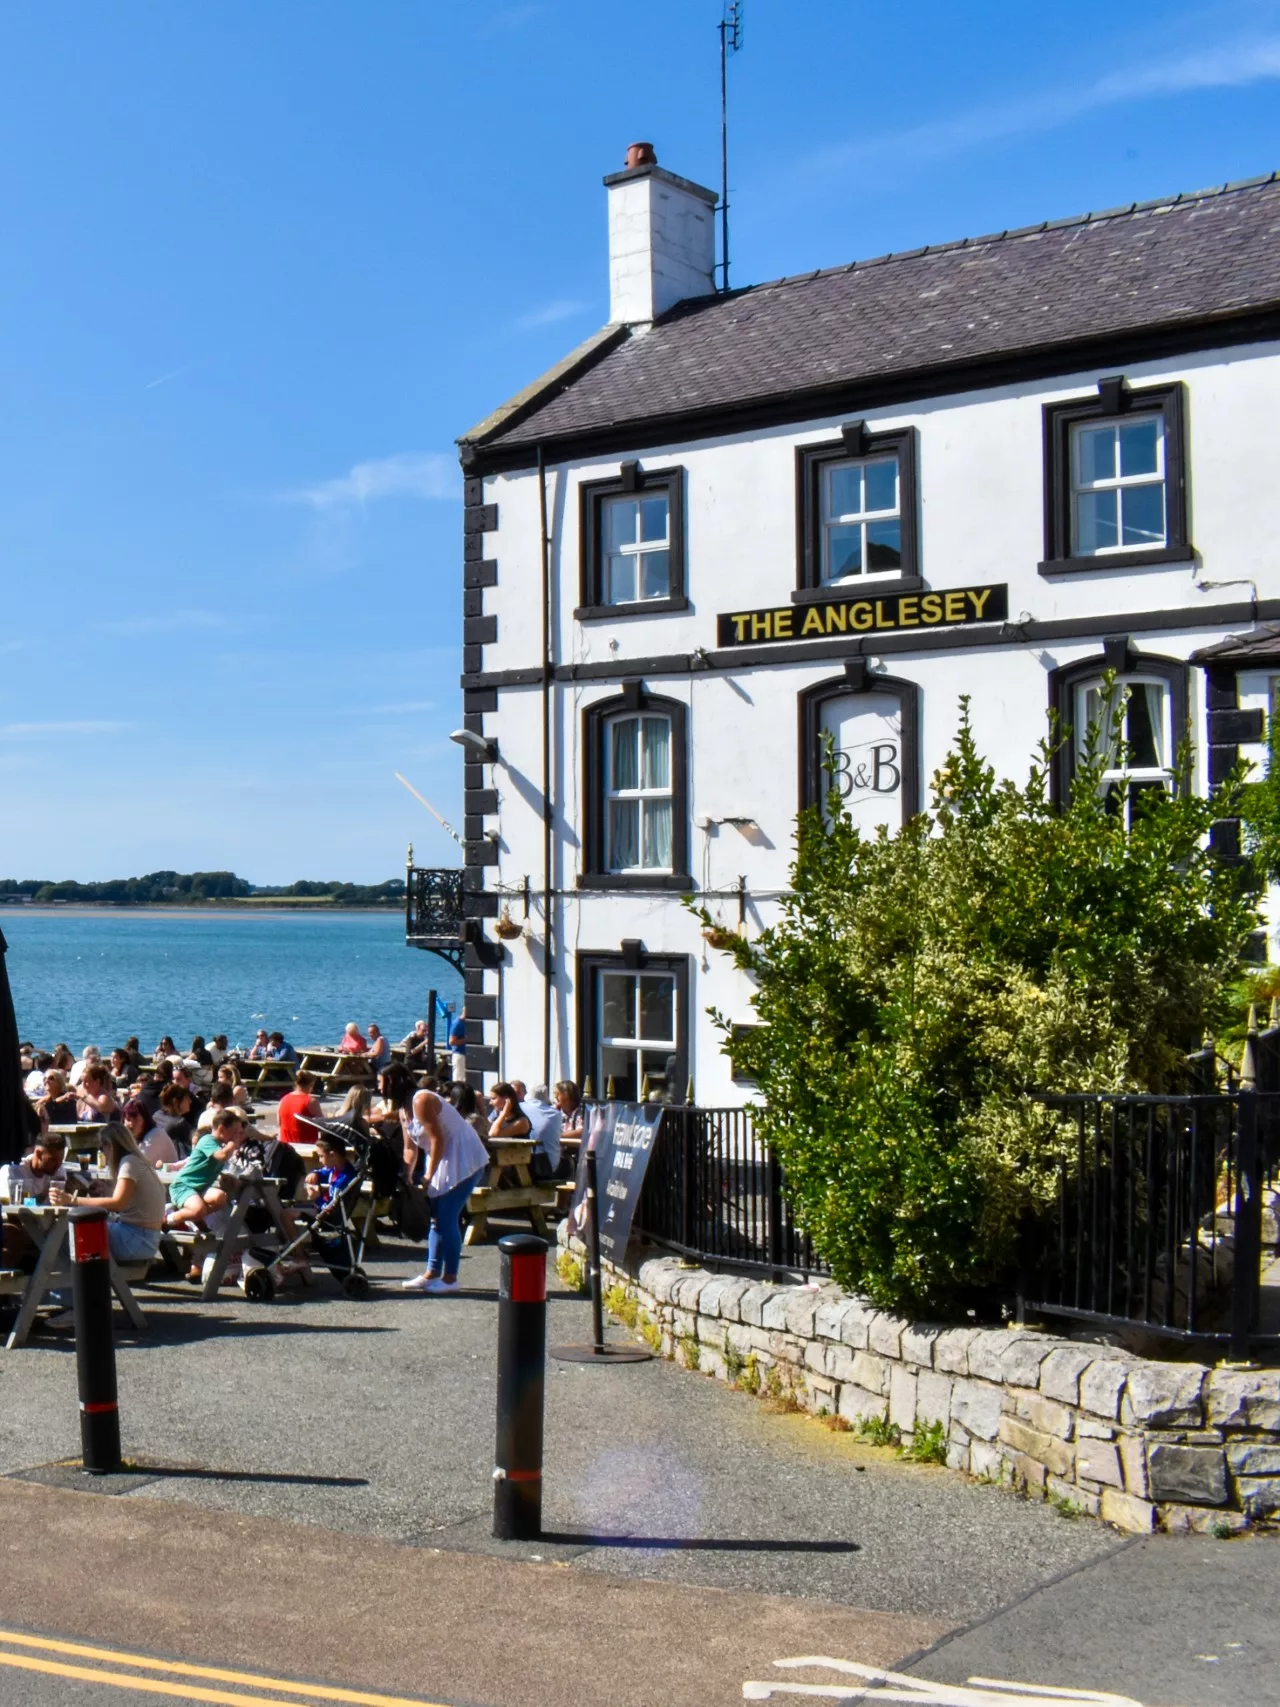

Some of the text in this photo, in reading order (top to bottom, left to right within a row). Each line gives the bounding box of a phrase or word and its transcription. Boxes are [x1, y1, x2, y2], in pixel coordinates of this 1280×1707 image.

[731, 589, 991, 642] THE ANGLESEY
[829, 744, 901, 800] B&B
